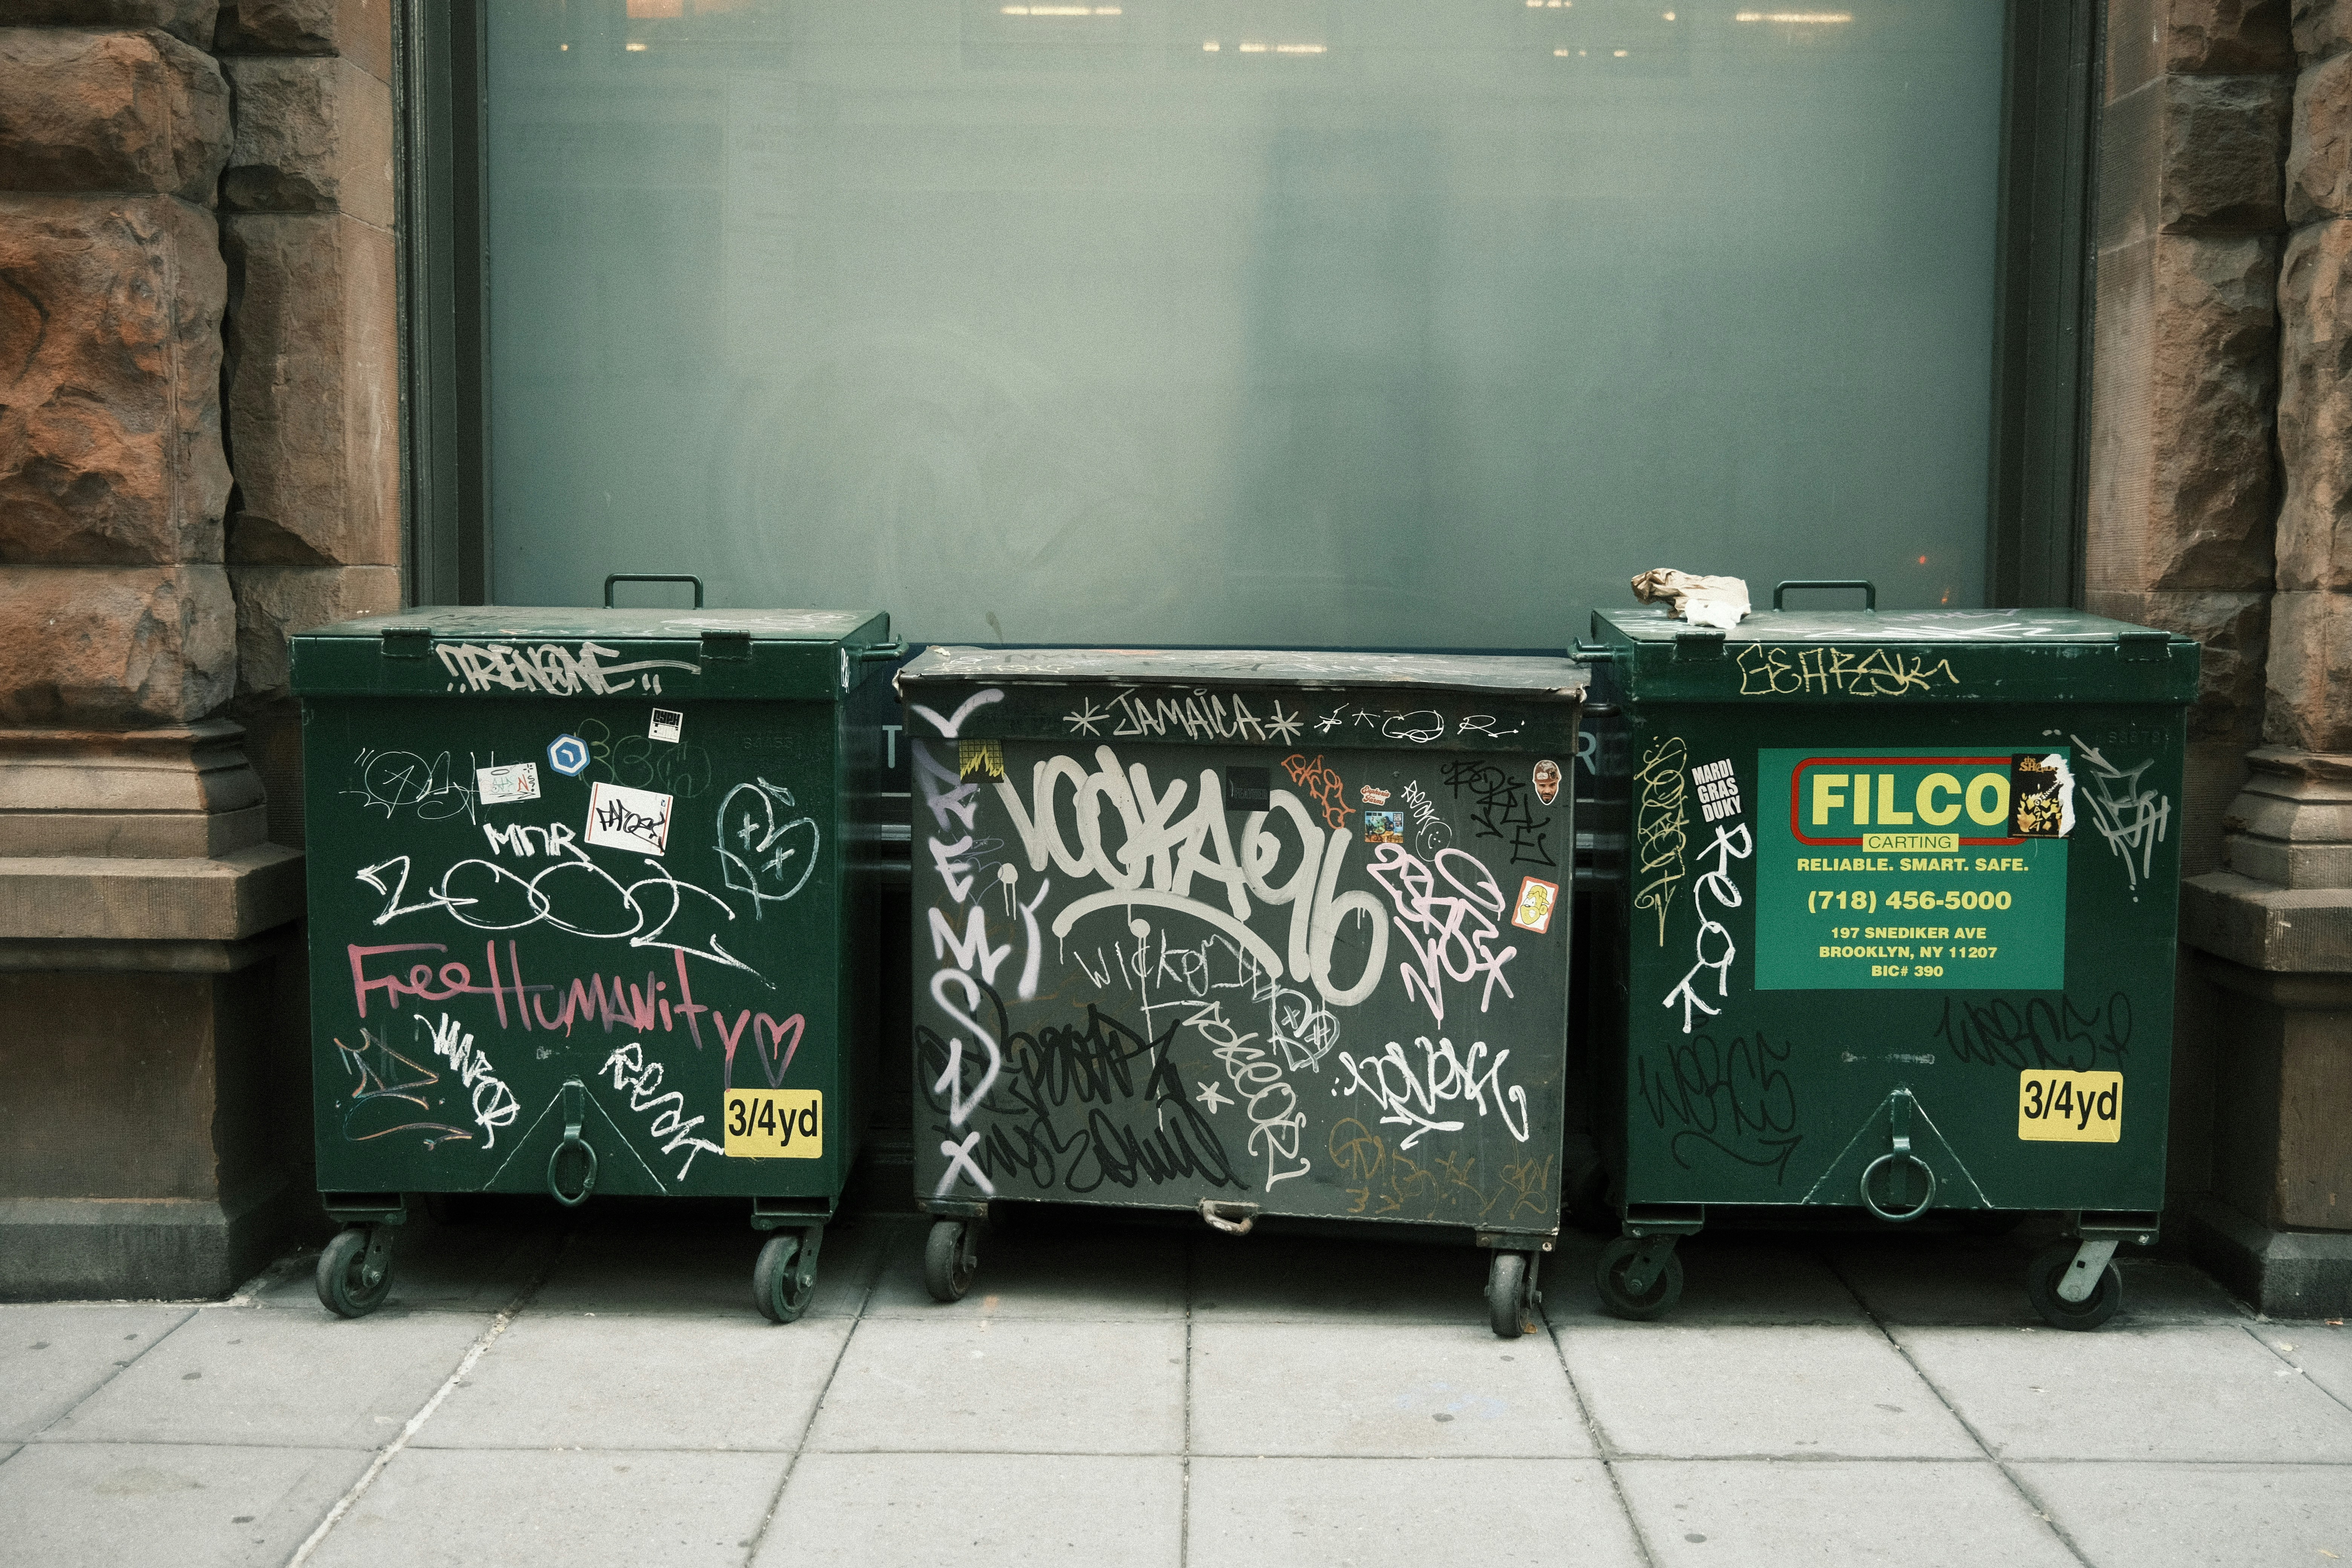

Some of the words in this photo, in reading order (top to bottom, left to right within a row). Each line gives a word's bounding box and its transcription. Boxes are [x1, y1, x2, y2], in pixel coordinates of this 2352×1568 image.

[1691, 758, 1734, 786] MARDI
[1361, 786, 1390, 798] Euphoria
[1697, 777, 1738, 804] GRAS
[1812, 772, 2011, 825] FILCO
[1363, 795, 1384, 805] Farms
[1701, 795, 1741, 822] DUKY
[1868, 835, 1951, 849] CARTING
[1798, 858, 1893, 871] RELIABLE.
[1900, 858, 1969, 871] SMART.
[1975, 858, 2028, 871] SAFE.
[1808, 891, 1876, 914] (718)
[1886, 891, 2011, 910] 456-5000
[1832, 928, 1859, 939] 197
[1865, 927, 1949, 939] SNEDIKER
[1954, 928, 1986, 939] AVE
[1819, 946, 1914, 959] BROOKLYN,
[1920, 946, 1943, 957] NY
[1949, 947, 1997, 958] 11207
[1872, 965, 1908, 977] BIC#
[1914, 965, 1943, 977] 390
[2024, 1079, 2118, 1130] 3/4yd
[728, 1098, 818, 1147] 3/4yd
